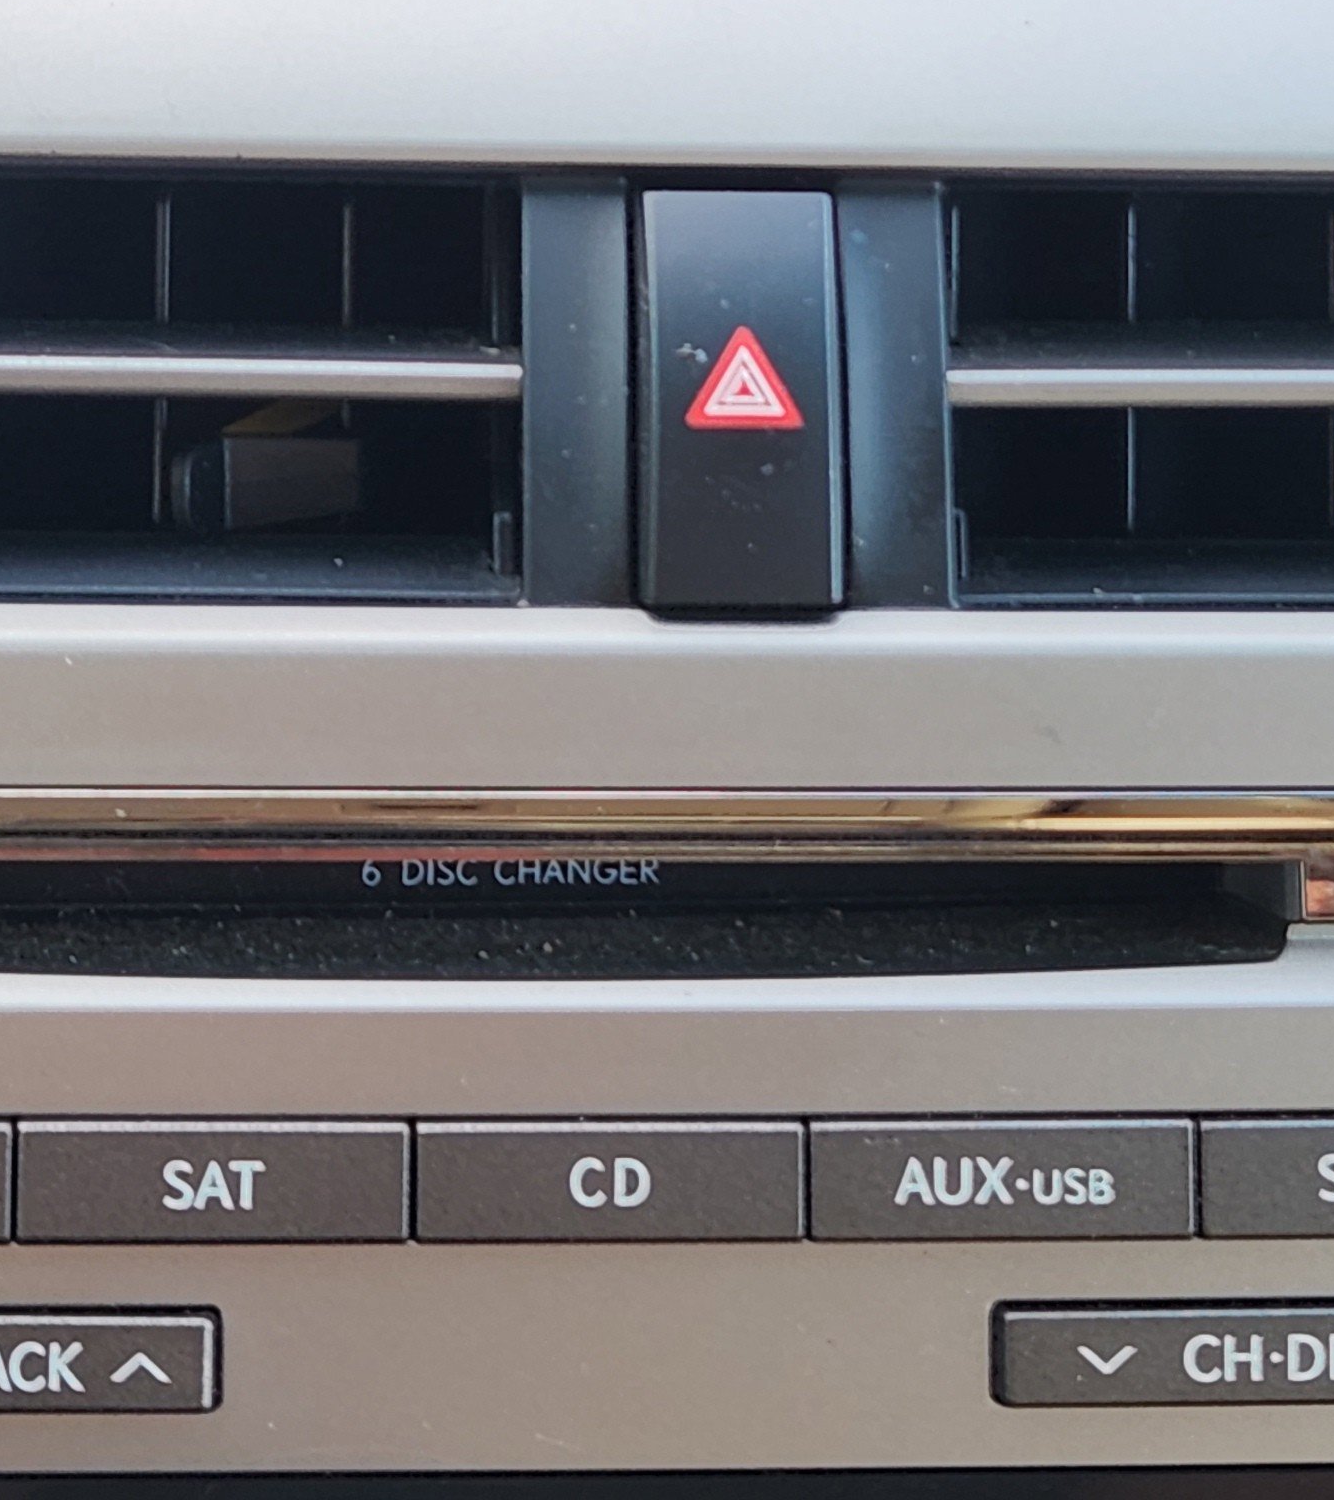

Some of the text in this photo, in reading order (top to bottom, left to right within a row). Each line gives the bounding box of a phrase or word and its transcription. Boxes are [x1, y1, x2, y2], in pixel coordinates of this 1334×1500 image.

[361, 858, 660, 887] 6 DISC CHANGER
[161, 1159, 267, 1212] SAT
[568, 1156, 652, 1208] CD
